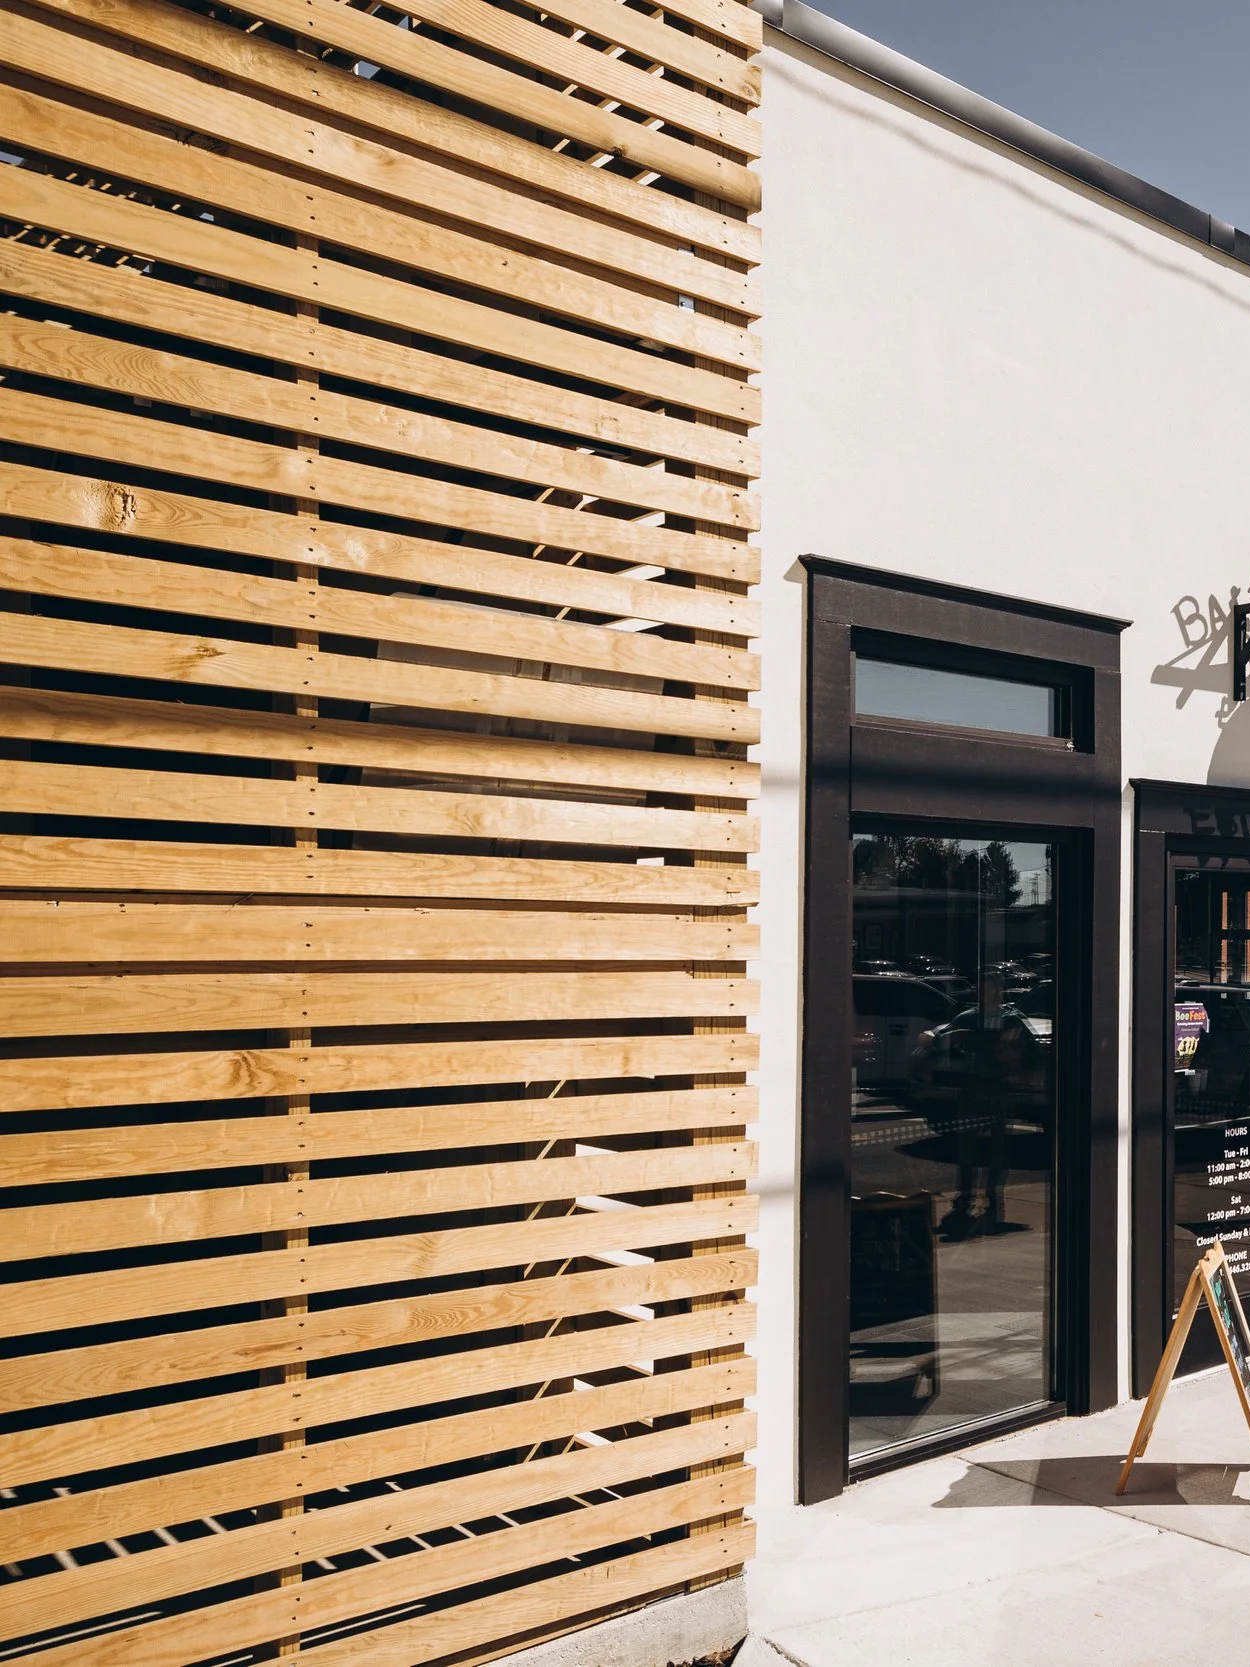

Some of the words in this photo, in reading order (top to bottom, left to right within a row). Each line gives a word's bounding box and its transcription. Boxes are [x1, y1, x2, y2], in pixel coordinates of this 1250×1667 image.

[1175, 1010, 1206, 1021] BooFest
[1224, 1126, 1248, 1138] HOURS
[1224, 1149, 1236, 1159] Tue
[1240, 1146, 1249, 1156] Fri
[1207, 1162, 1225, 1174] 11:00
[1225, 1162, 1236, 1171] am
[1208, 1175, 1223, 1186] 5:00
[1223, 1174, 1234, 1185] pm
[1230, 1195, 1242, 1205] Sat
[1207, 1210, 1225, 1221] 12:00
[1225, 1209, 1236, 1220] pm
[1196, 1233, 1219, 1247] Closed
[1219, 1230, 1242, 1242] Sunday
[1243, 1227, 1249, 1237] &
